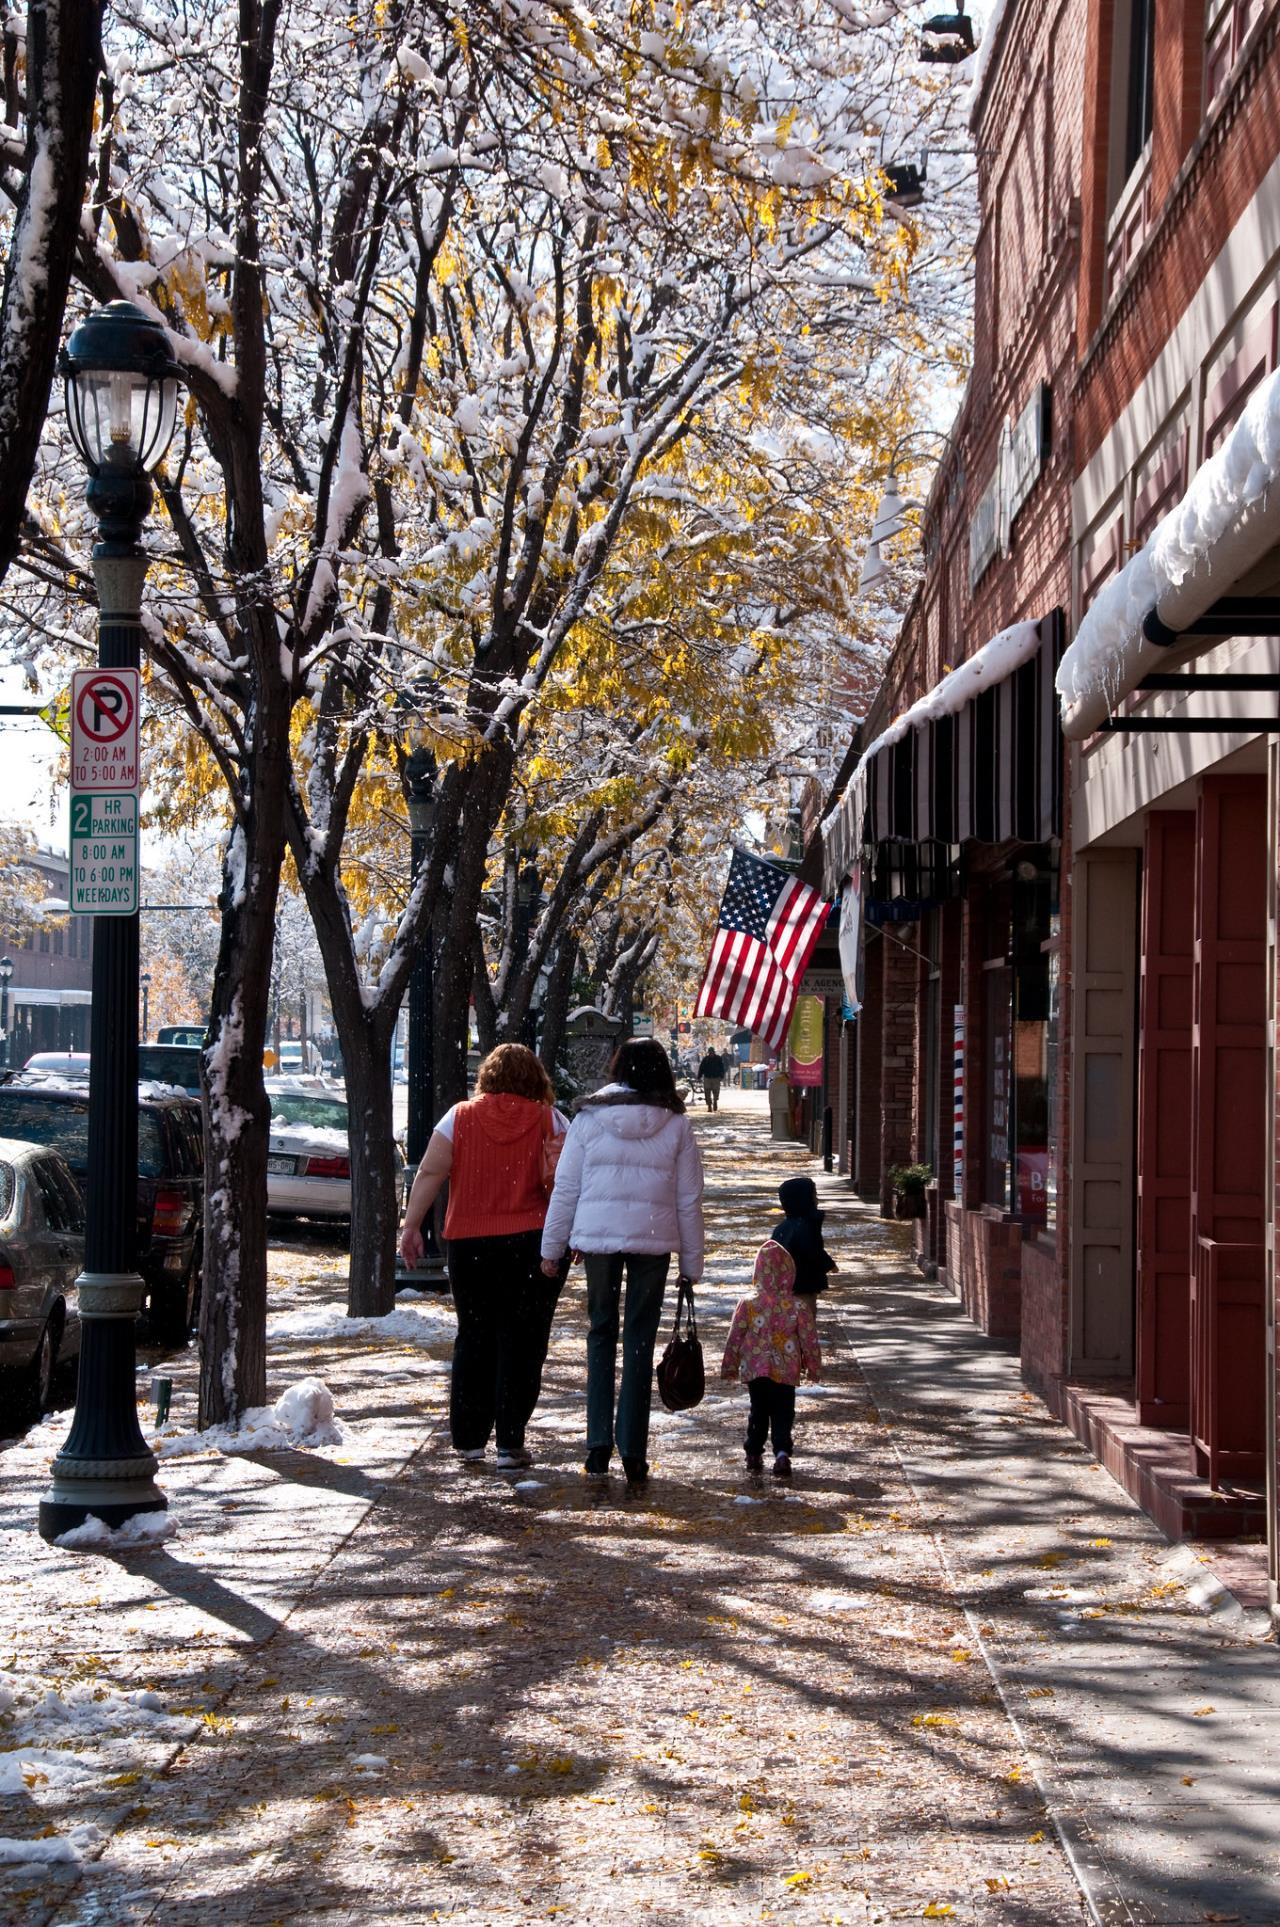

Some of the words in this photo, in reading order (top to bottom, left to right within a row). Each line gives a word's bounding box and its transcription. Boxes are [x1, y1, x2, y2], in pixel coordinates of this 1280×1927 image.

[83, 746, 108, 762] 2:00
[112, 746, 126, 761] AM
[75, 766, 87, 781] TO
[91, 766, 116, 781] 5:00
[120, 765, 135, 780] AM
[74, 802, 89, 833] 2
[104, 800, 121, 815] HR
[92, 818, 134, 835] PARKING
[82, 845, 107, 860] 8:00
[111, 844, 125, 860] AM
[74, 867, 86, 882] TO
[90, 866, 115, 882] 6:00
[119, 866, 133, 881] PM
[76, 887, 130, 903] WEEKDAYS
[814, 979, 844, 988] AGENC
